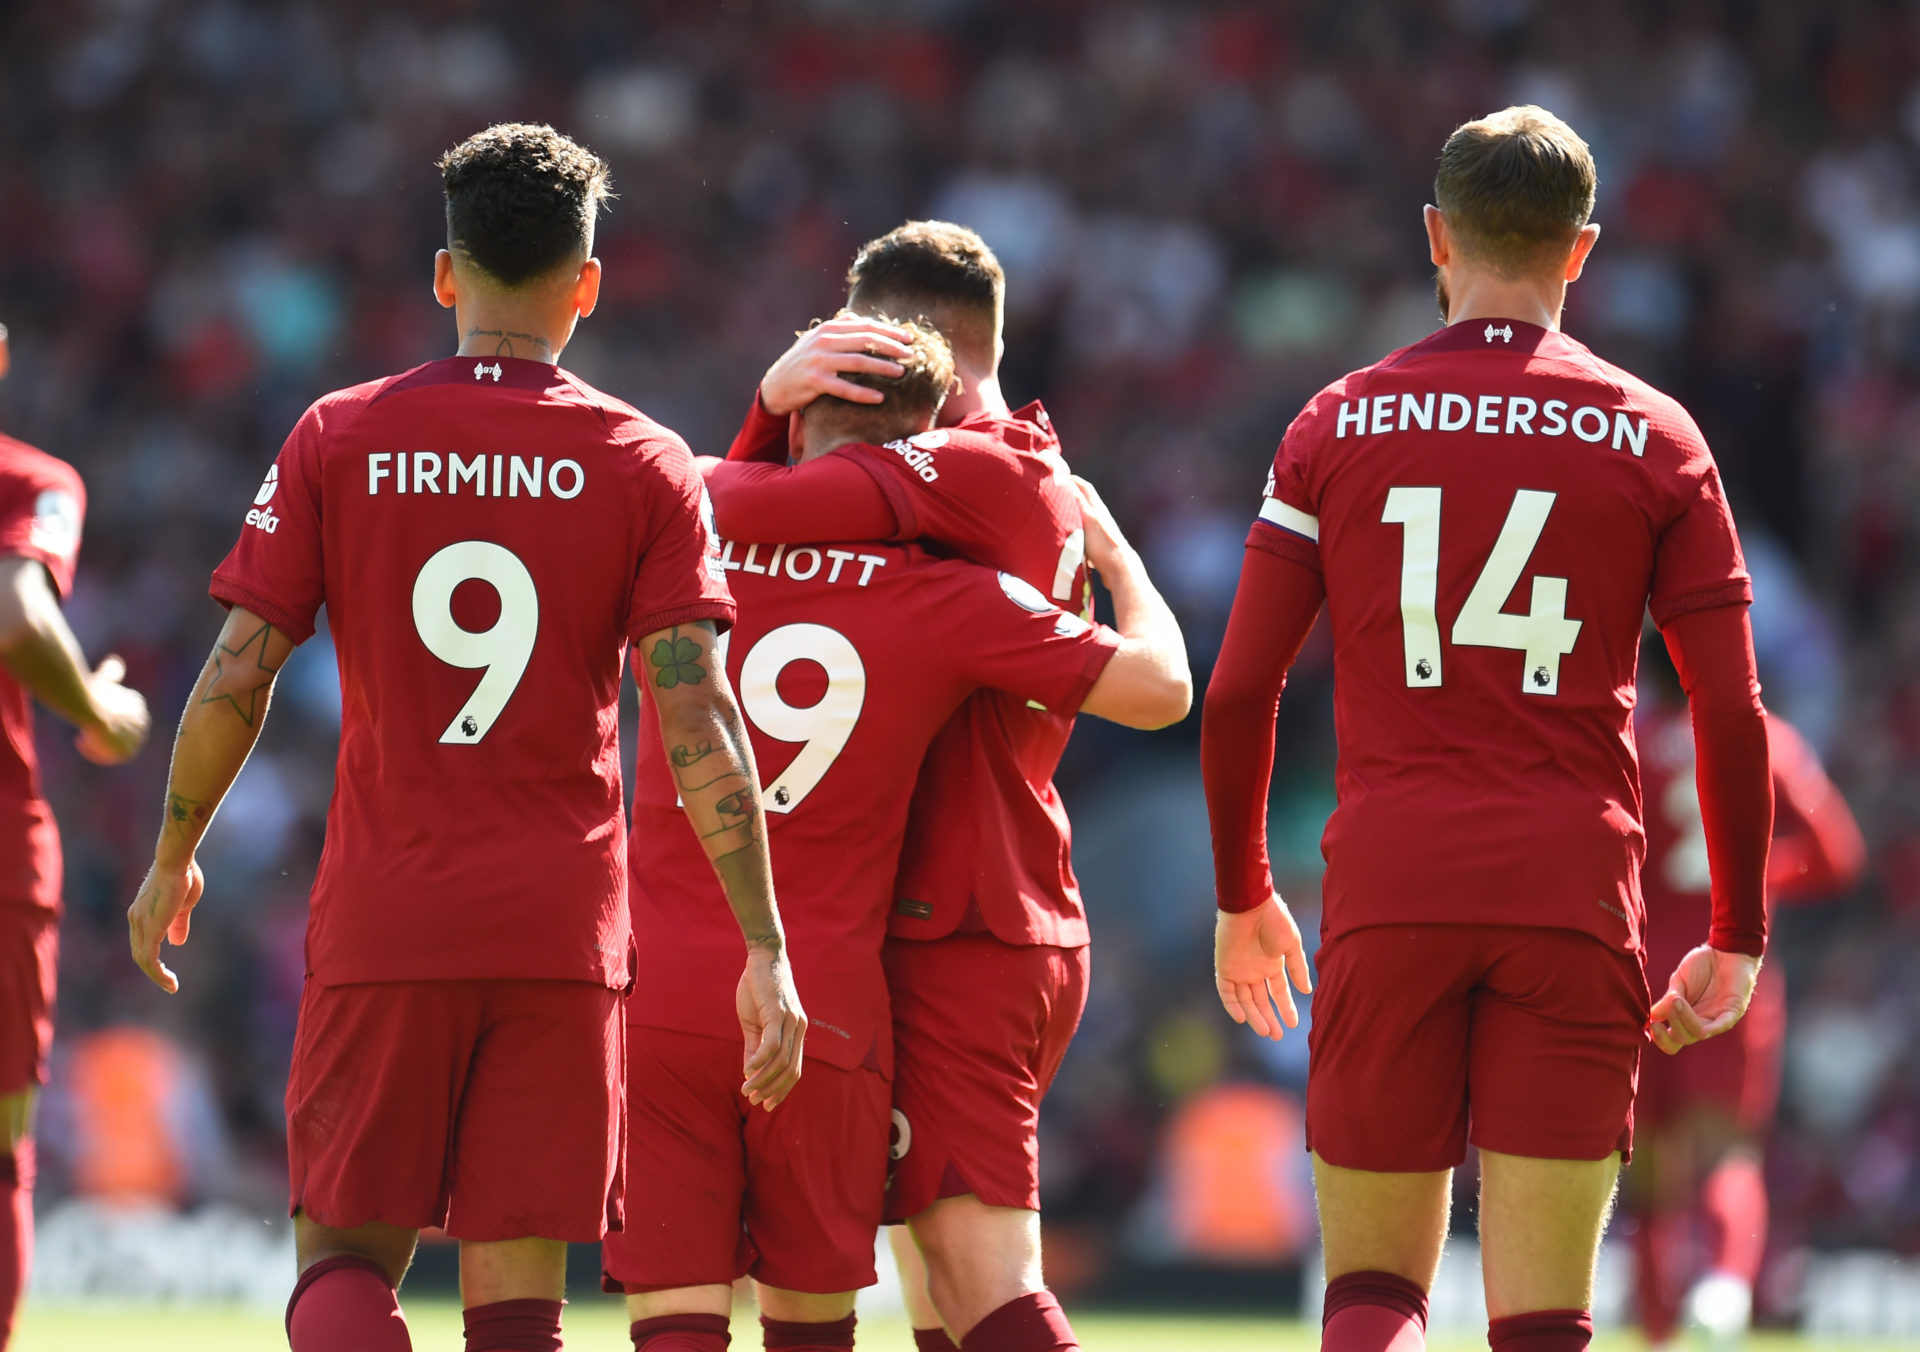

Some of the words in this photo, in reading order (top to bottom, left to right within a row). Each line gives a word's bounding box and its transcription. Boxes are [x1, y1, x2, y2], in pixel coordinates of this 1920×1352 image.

[368, 452, 585, 500] FIRMINO
[1336, 393, 1648, 457] HENDERSON
[720, 541, 886, 587] LLIOTT
[1381, 486, 1584, 695] 14
[412, 540, 539, 745] 9
[717, 622, 866, 814] 9
